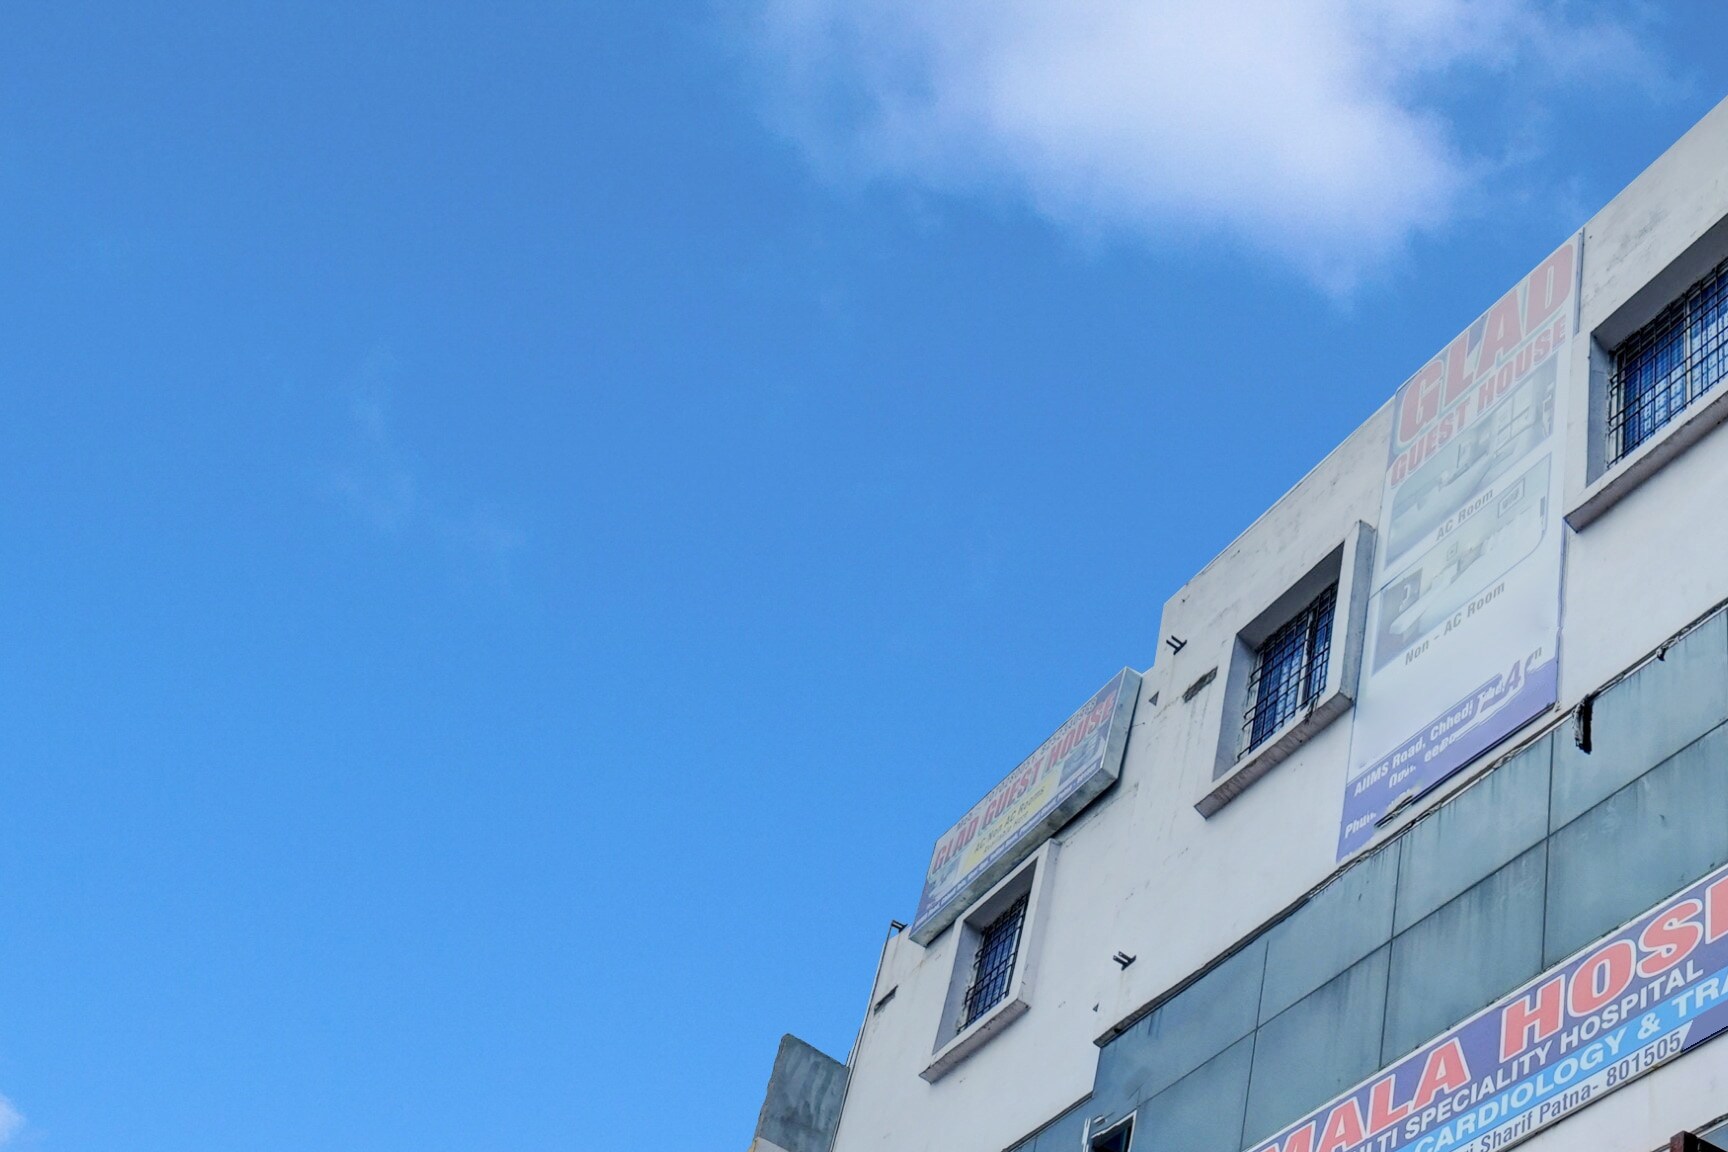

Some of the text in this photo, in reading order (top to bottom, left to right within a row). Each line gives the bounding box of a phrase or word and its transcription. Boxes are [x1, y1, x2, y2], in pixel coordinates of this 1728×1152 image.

[1390, 314, 1567, 489] GUEST HOUSE
[1399, 244, 1574, 443] GLAD
[1436, 489, 1494, 542] AC Room
[1404, 642, 1430, 665] Non
[1443, 614, 1463, 636] AC
[1467, 582, 1506, 617] Room
[932, 815, 979, 874] GLAD
[982, 756, 1045, 828] GUEST
[1049, 691, 1118, 768] HOUSE
[1404, 1040, 1554, 1140] SPECIALITY
[1560, 960, 1704, 1056] HOSPITAL
[1605, 1030, 1682, 1087] 801505
[1637, 1013, 1661, 1040] &
